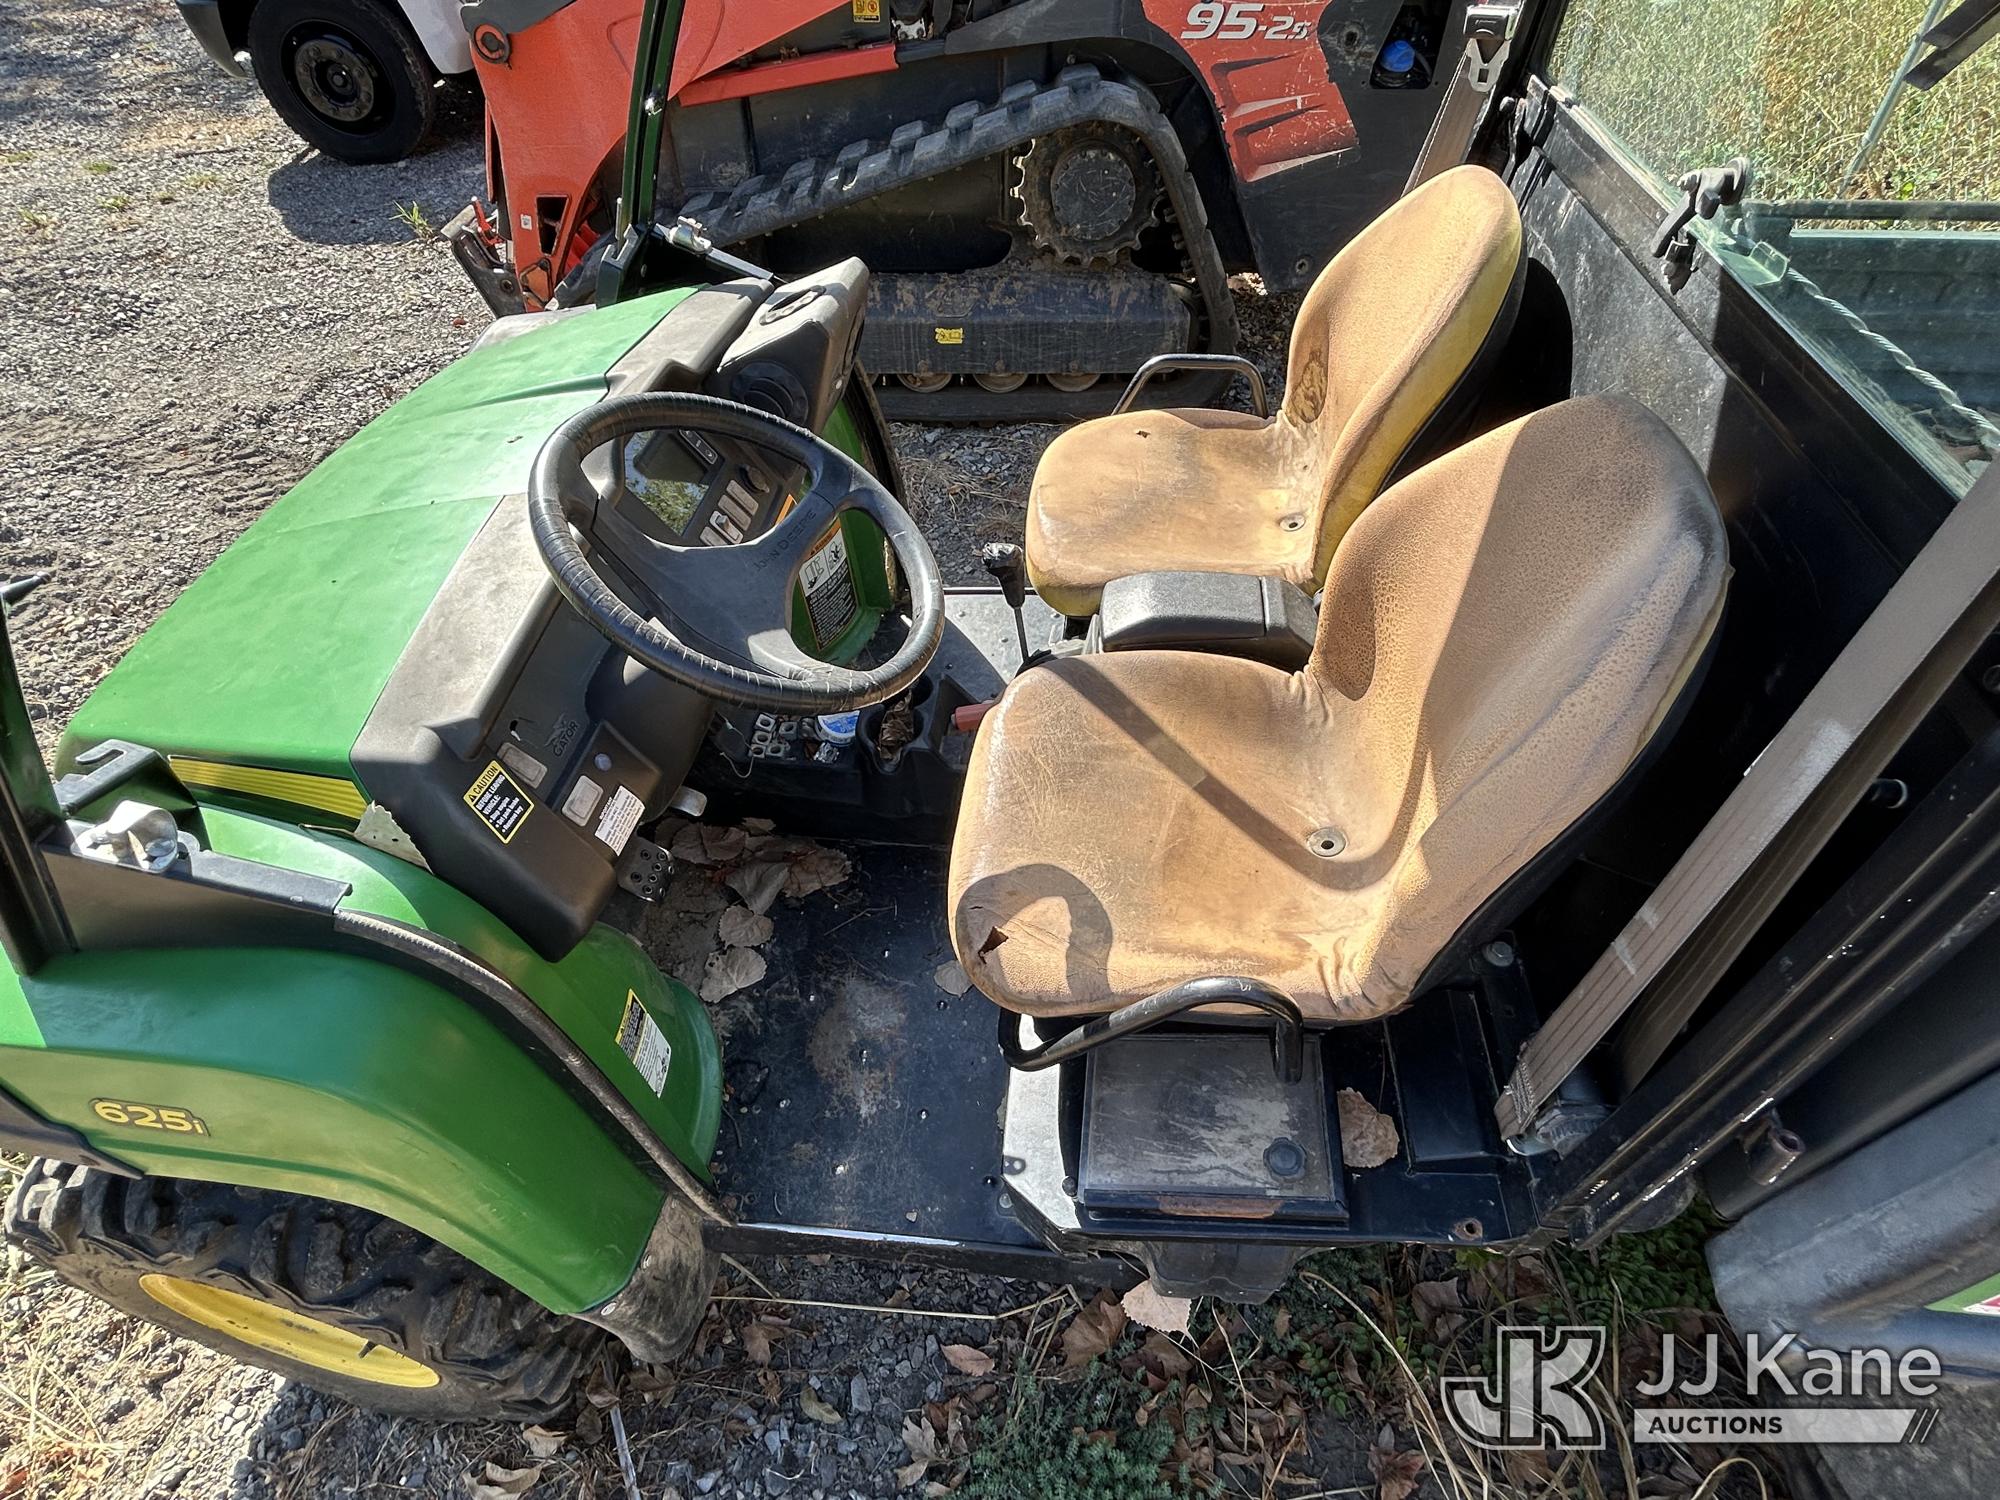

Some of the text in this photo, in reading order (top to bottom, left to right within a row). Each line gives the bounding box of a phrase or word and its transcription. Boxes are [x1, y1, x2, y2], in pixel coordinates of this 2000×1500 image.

[777, 509, 817, 551] DEERE
[553, 720, 579, 757] GATOR
[473, 765, 499, 794] CAUTION
[475, 774, 506, 811] BEFORE LEAVING
[94, 1101, 204, 1135] 625i
